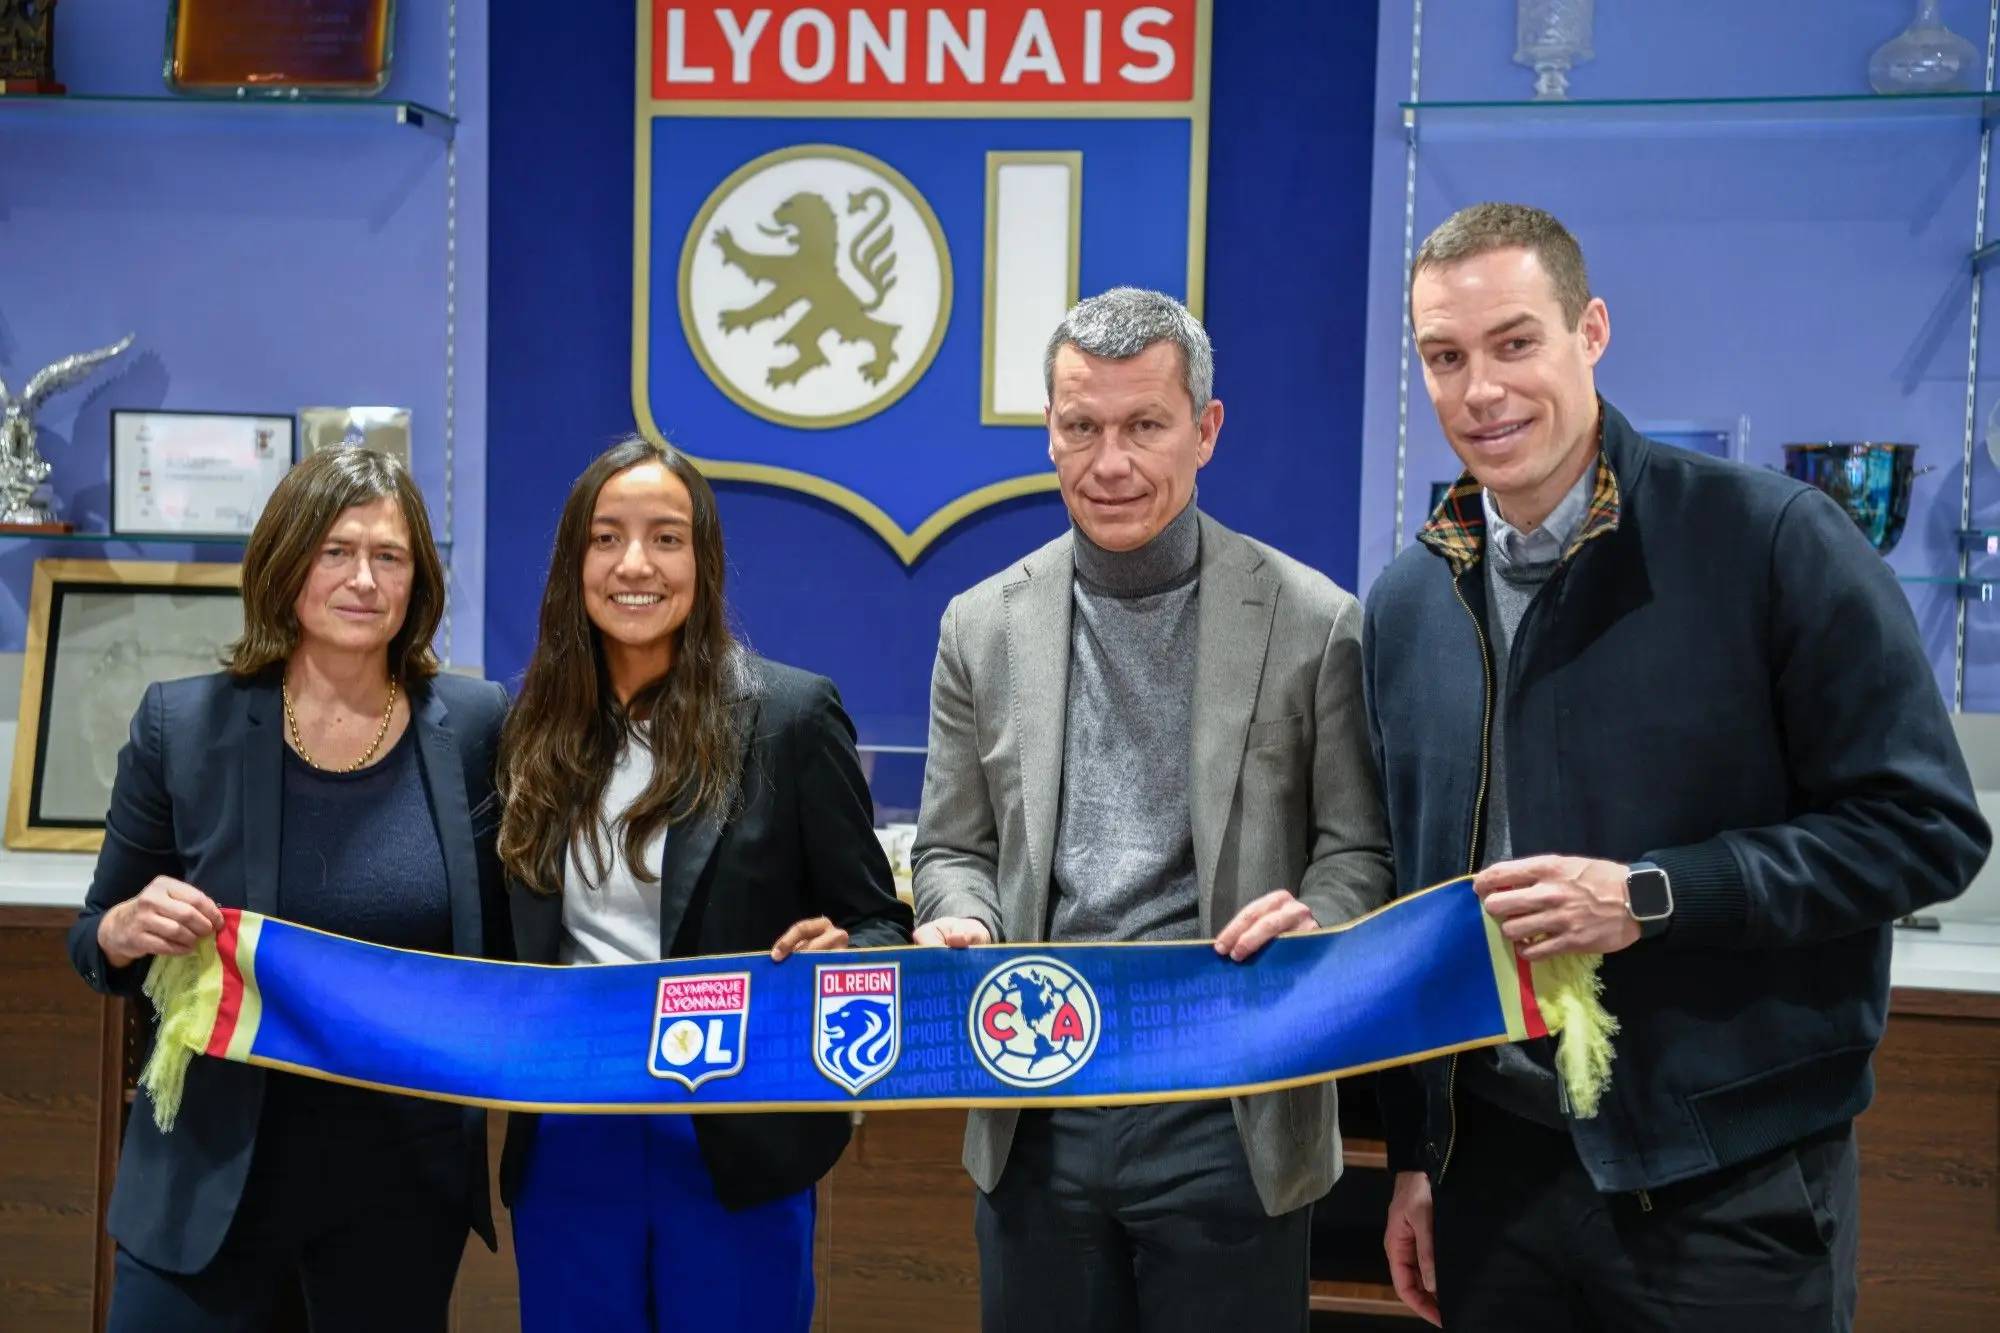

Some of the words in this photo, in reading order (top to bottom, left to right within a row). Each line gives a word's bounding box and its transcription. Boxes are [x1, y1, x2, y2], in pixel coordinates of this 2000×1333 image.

[667, 6, 1177, 84] LYONNAIS
[665, 981, 742, 997] OLYMPIQUE
[823, 973, 844, 993] OL
[845, 971, 892, 992] REIGN
[664, 994, 741, 1012] LYONNAIS
[661, 1019, 732, 1066] OL
